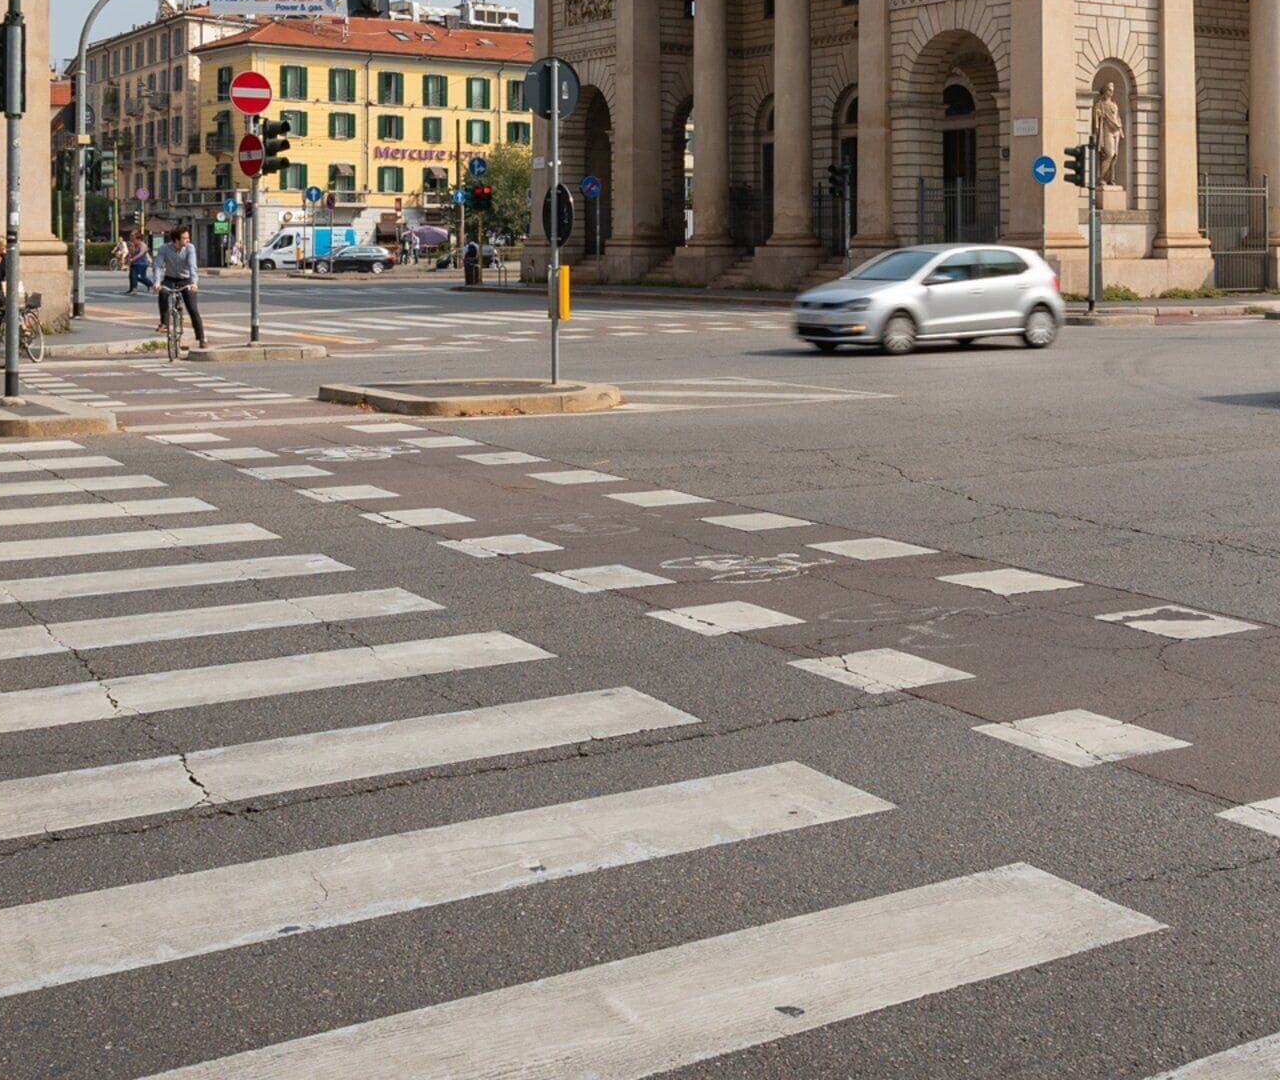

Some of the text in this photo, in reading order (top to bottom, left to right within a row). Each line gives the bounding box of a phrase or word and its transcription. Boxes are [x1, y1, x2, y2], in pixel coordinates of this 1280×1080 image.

[275, 3, 298, 11] Power
[300, 3, 306, 11] &
[374, 146, 446, 161] Mercure
